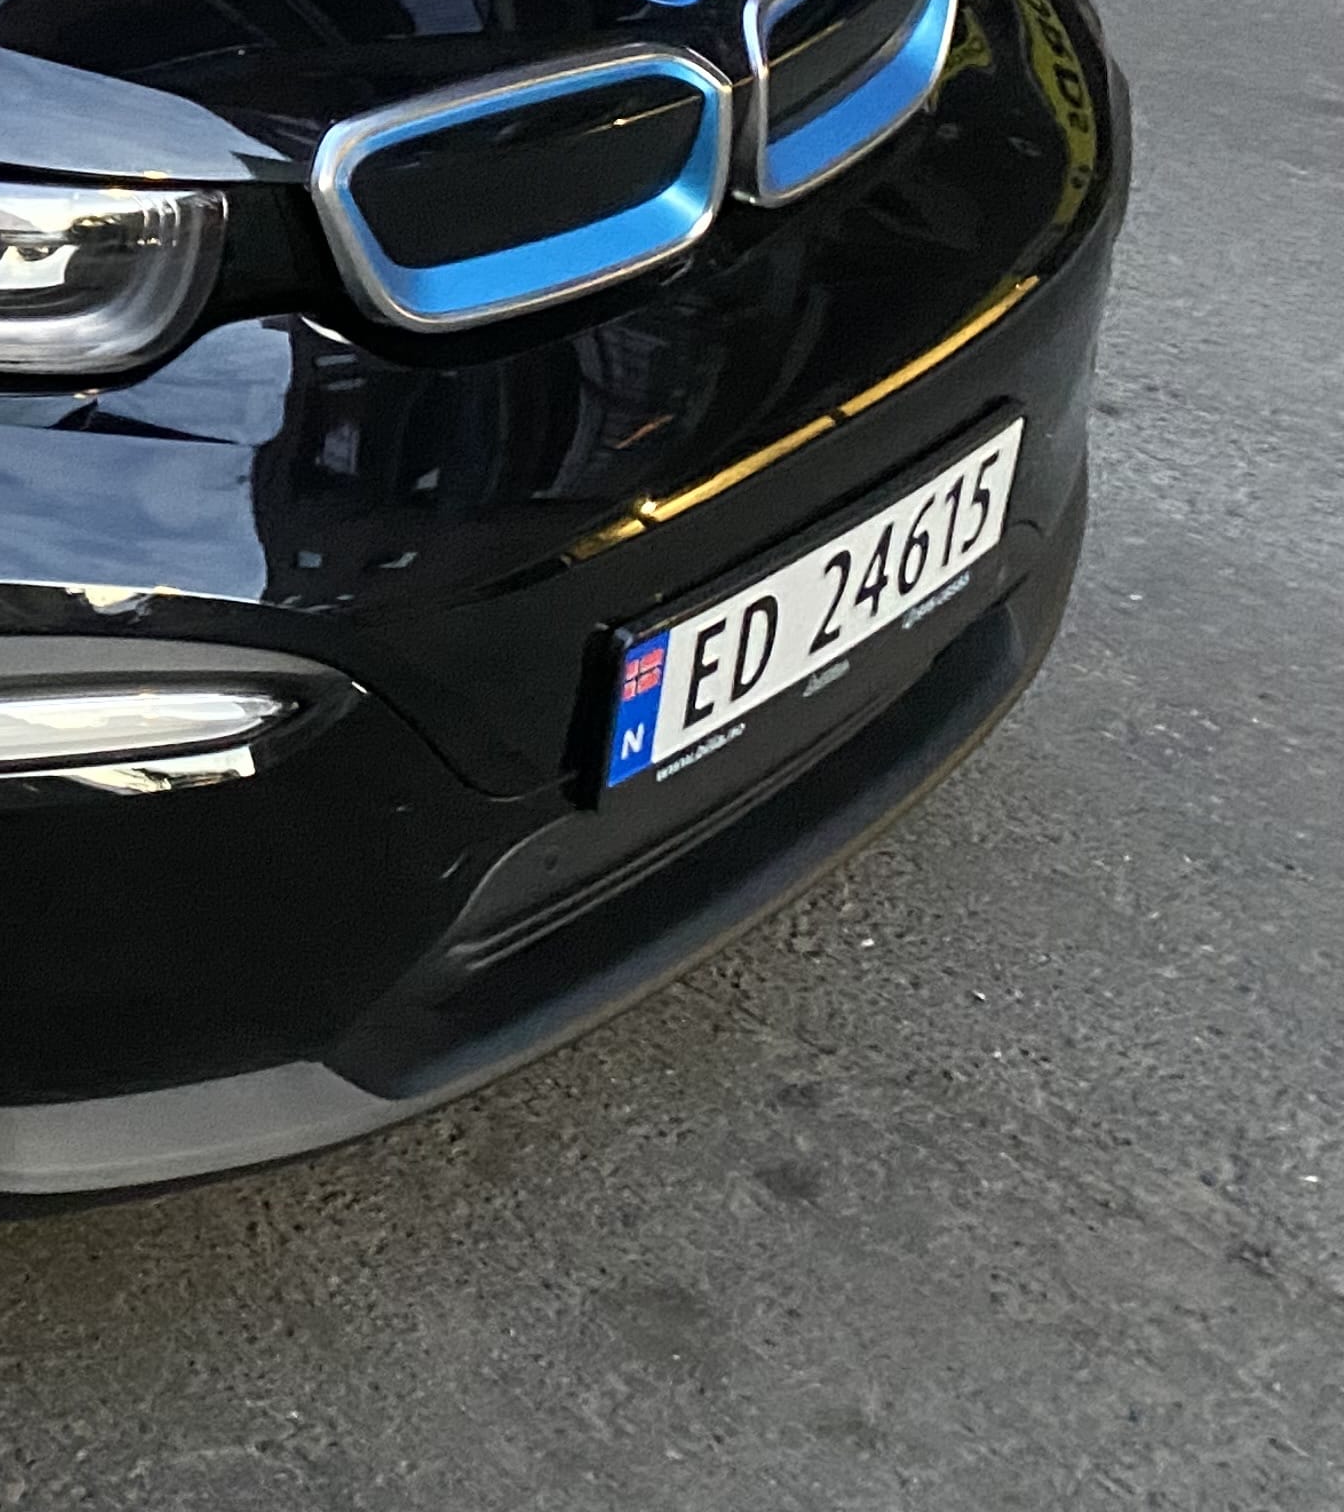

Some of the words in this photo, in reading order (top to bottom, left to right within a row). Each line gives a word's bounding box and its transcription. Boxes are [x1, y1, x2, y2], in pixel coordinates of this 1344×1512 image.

[683, 595, 779, 730] ED
[809, 450, 1001, 656] 24615
[621, 722, 645, 760] N
